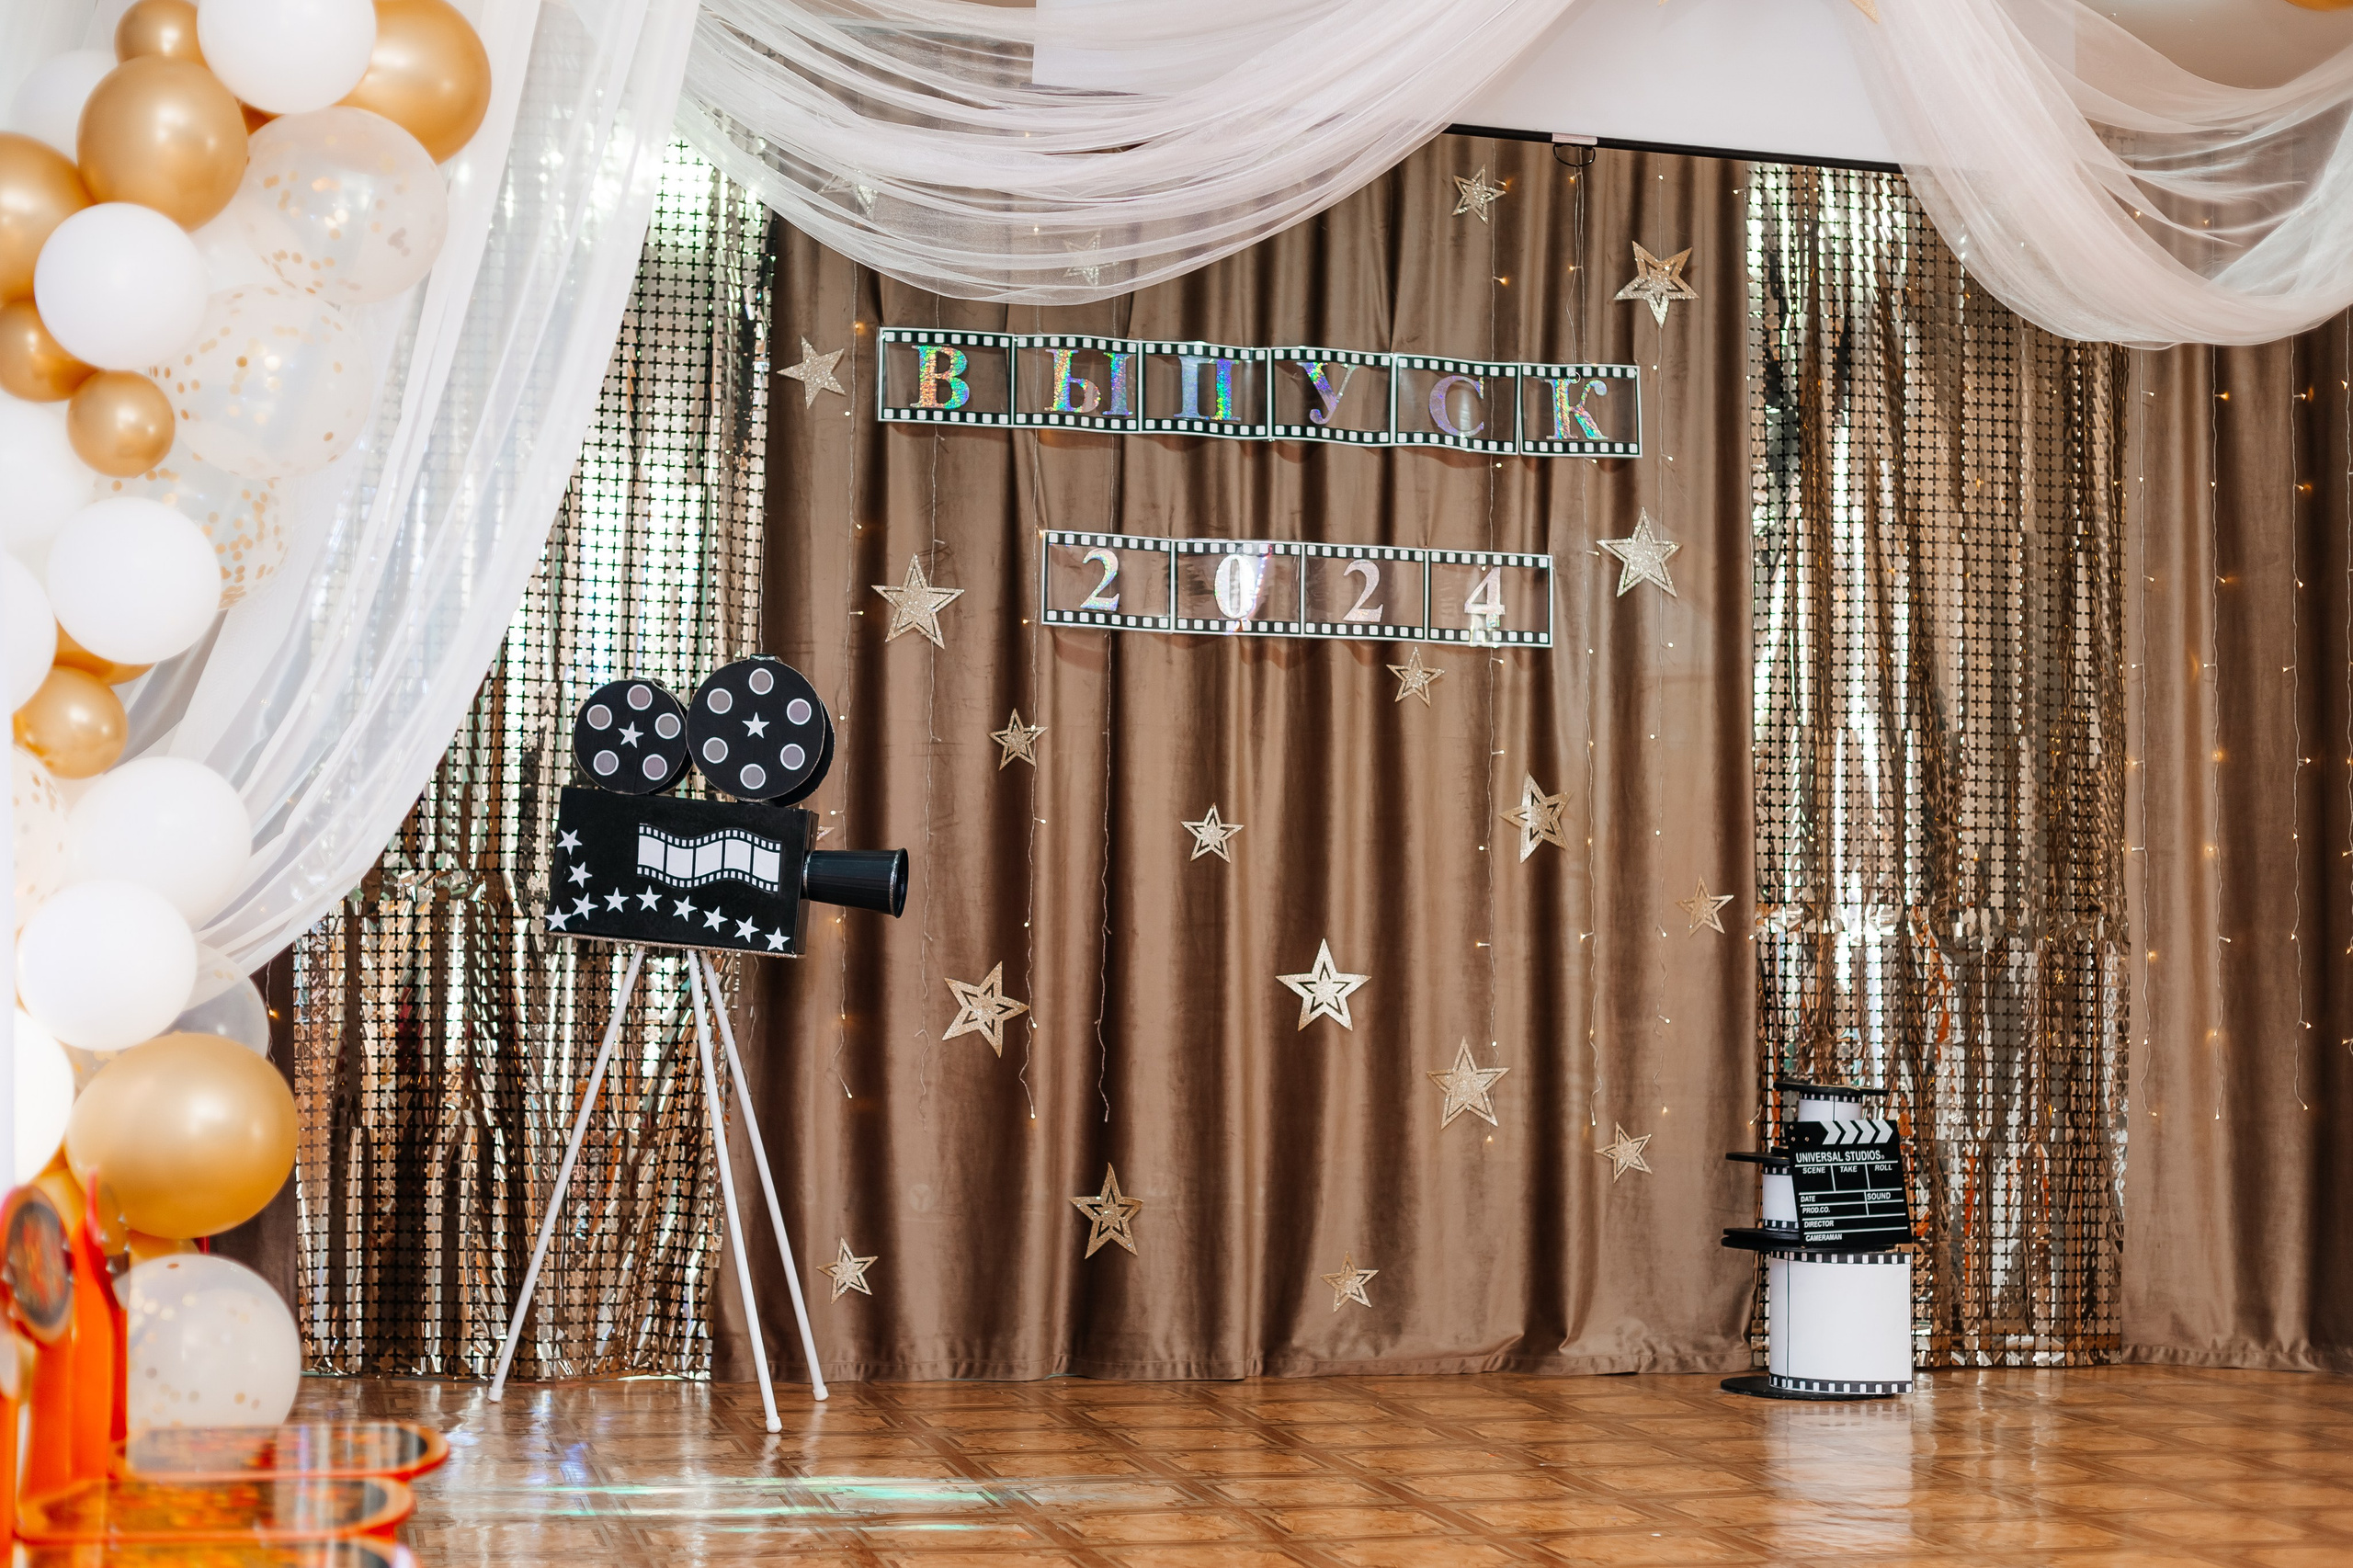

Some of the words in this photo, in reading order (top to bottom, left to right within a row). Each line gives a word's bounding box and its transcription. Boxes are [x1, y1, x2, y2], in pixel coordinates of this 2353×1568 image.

[909, 343, 1609, 441] ВЫПУСК
[1080, 548, 1506, 629] 2024
[1795, 1151, 1844, 1164] UNIVERSAL
[1802, 1166, 1826, 1175] SCENE
[1874, 1164, 1893, 1172] ROLL
[1800, 1195, 1816, 1203] DATE
[1867, 1192, 1892, 1201] SOUND
[1803, 1220, 1835, 1228] DIRECTOR
[1805, 1233, 1843, 1242] CAMERAMAN
